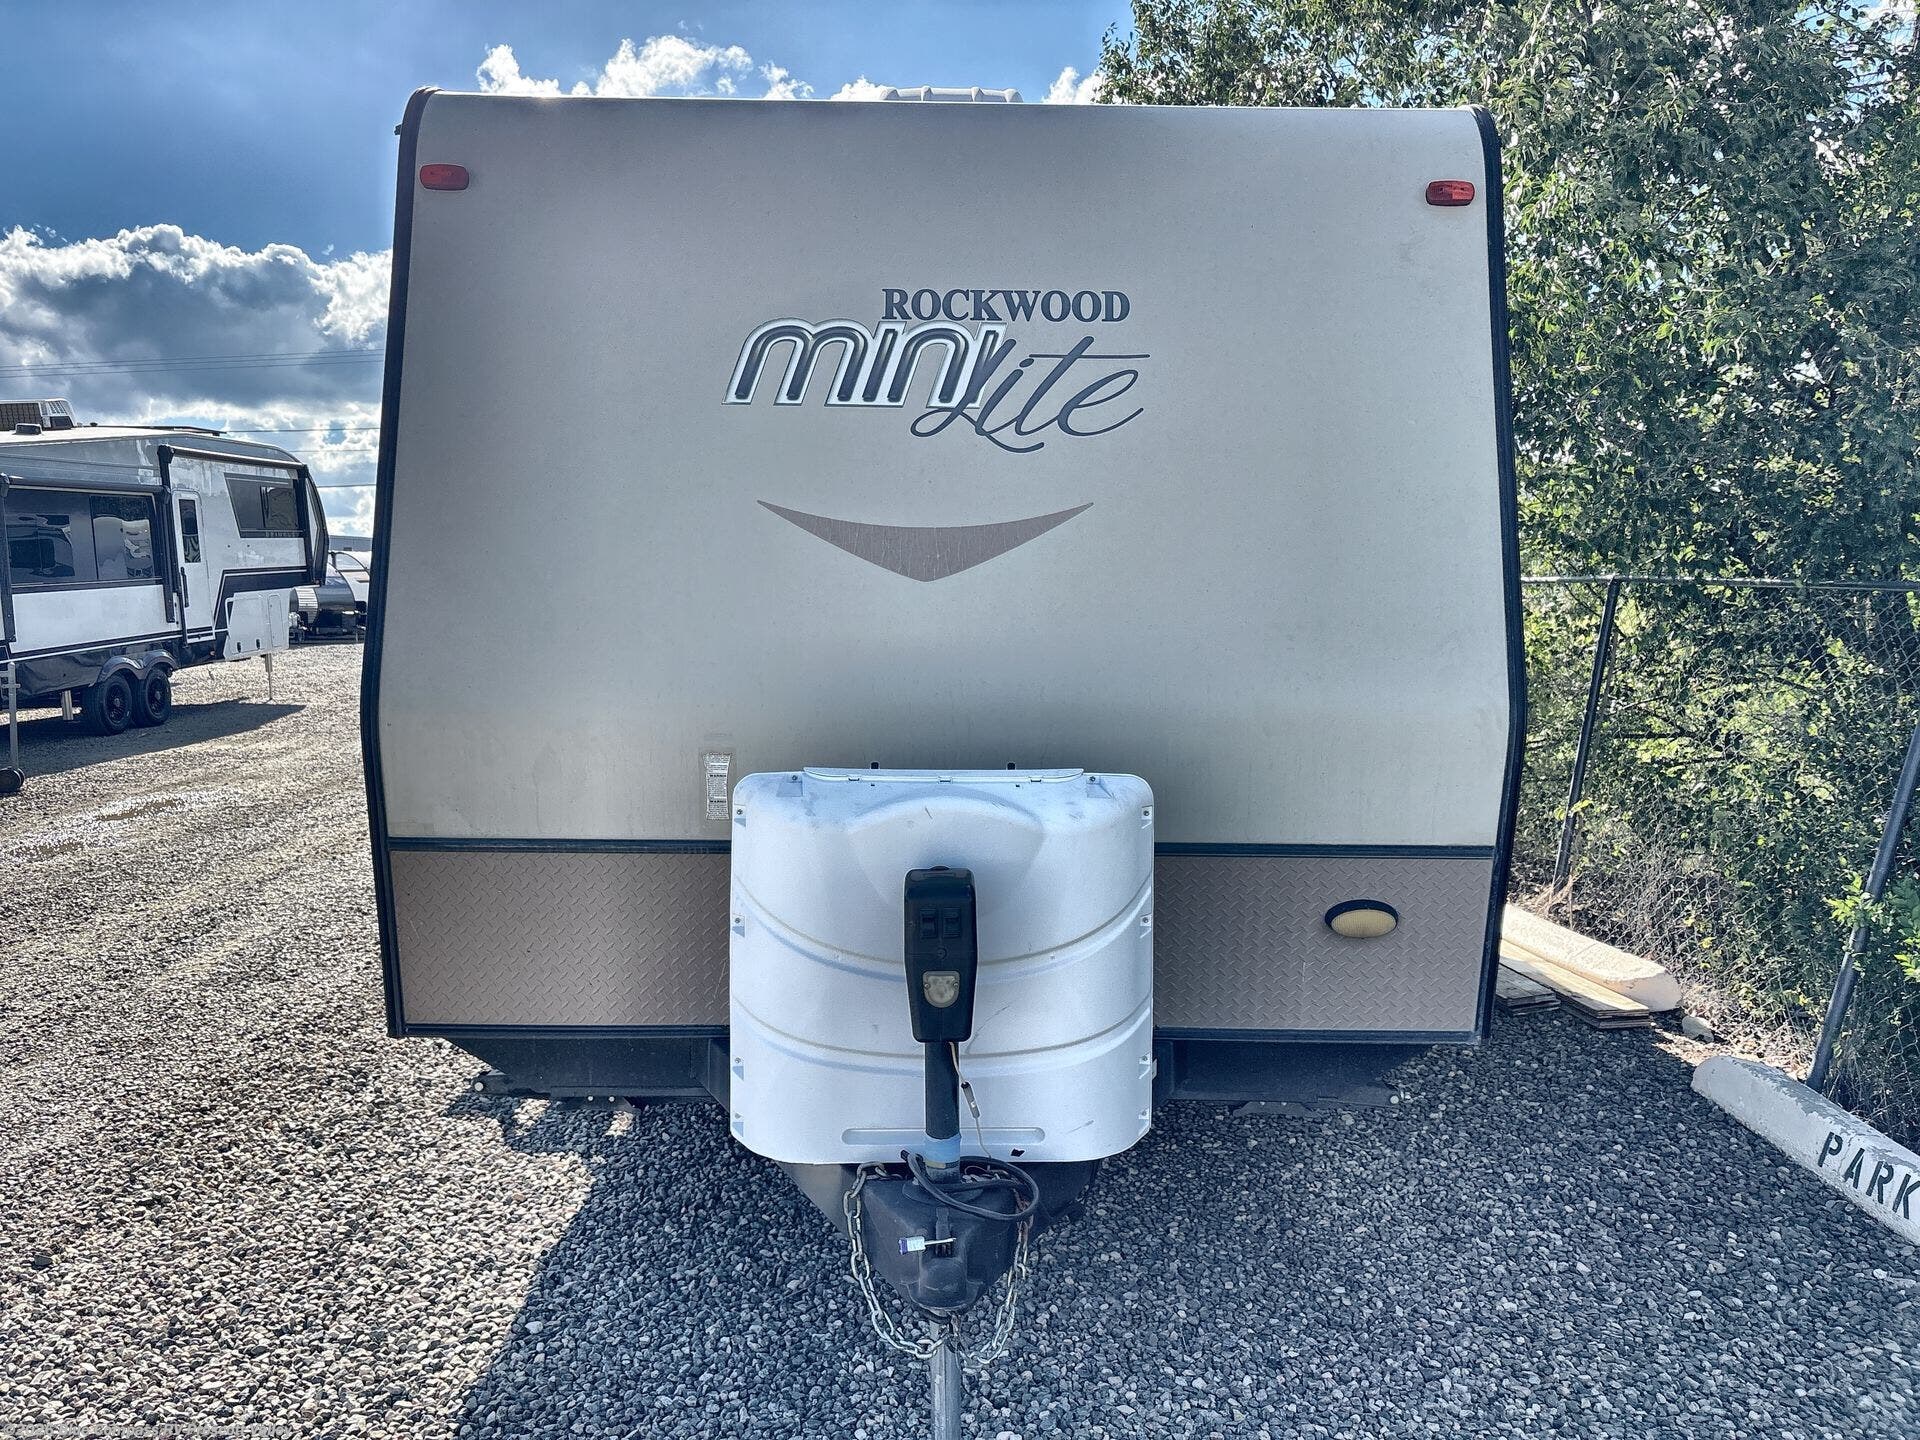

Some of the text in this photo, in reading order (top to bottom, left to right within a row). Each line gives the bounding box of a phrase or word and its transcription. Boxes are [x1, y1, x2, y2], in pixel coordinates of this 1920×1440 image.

[881, 288, 1130, 322] ROCKWOOD
[910, 335, 1150, 453] Lite
[1818, 1131, 1920, 1220] PARK
